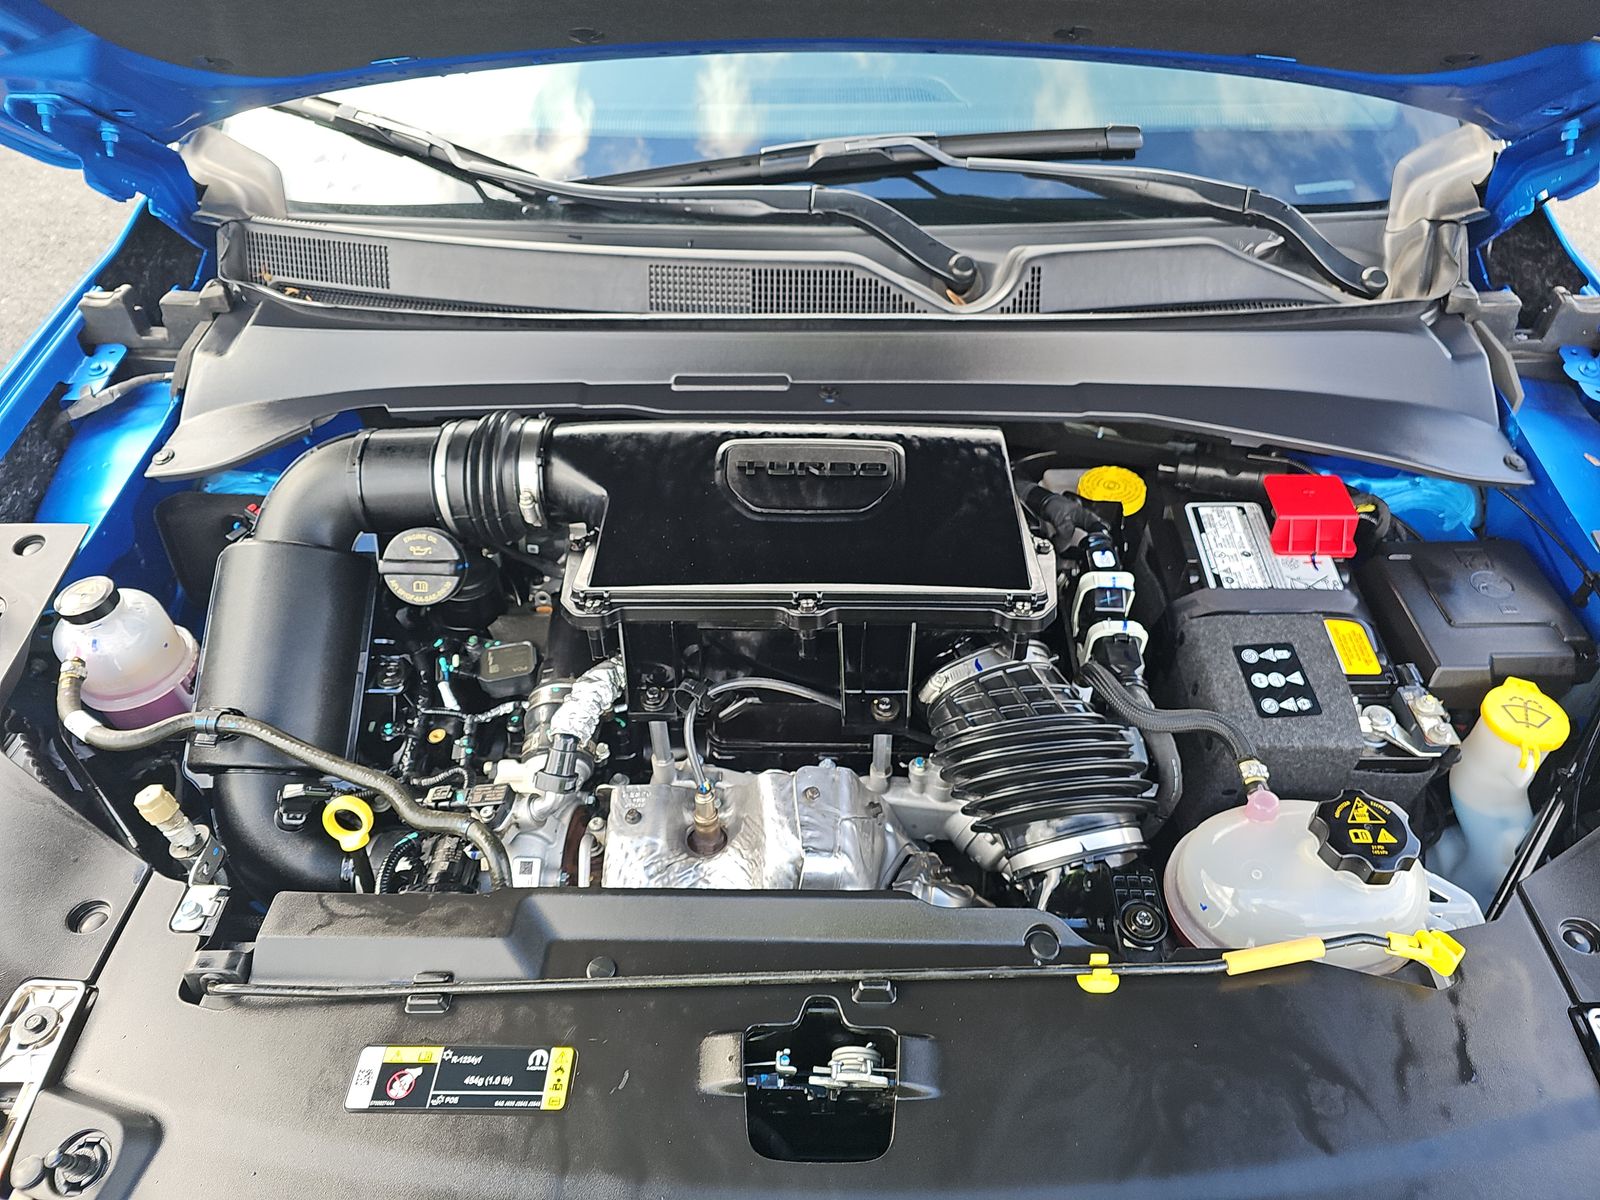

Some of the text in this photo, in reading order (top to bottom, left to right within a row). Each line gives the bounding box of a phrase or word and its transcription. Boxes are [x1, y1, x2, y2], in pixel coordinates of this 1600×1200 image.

[736, 461, 888, 476] TURBO
[403, 533, 438, 544] ENGINE OIL
[463, 1075, 513, 1087] 454g (1.0 lb)
